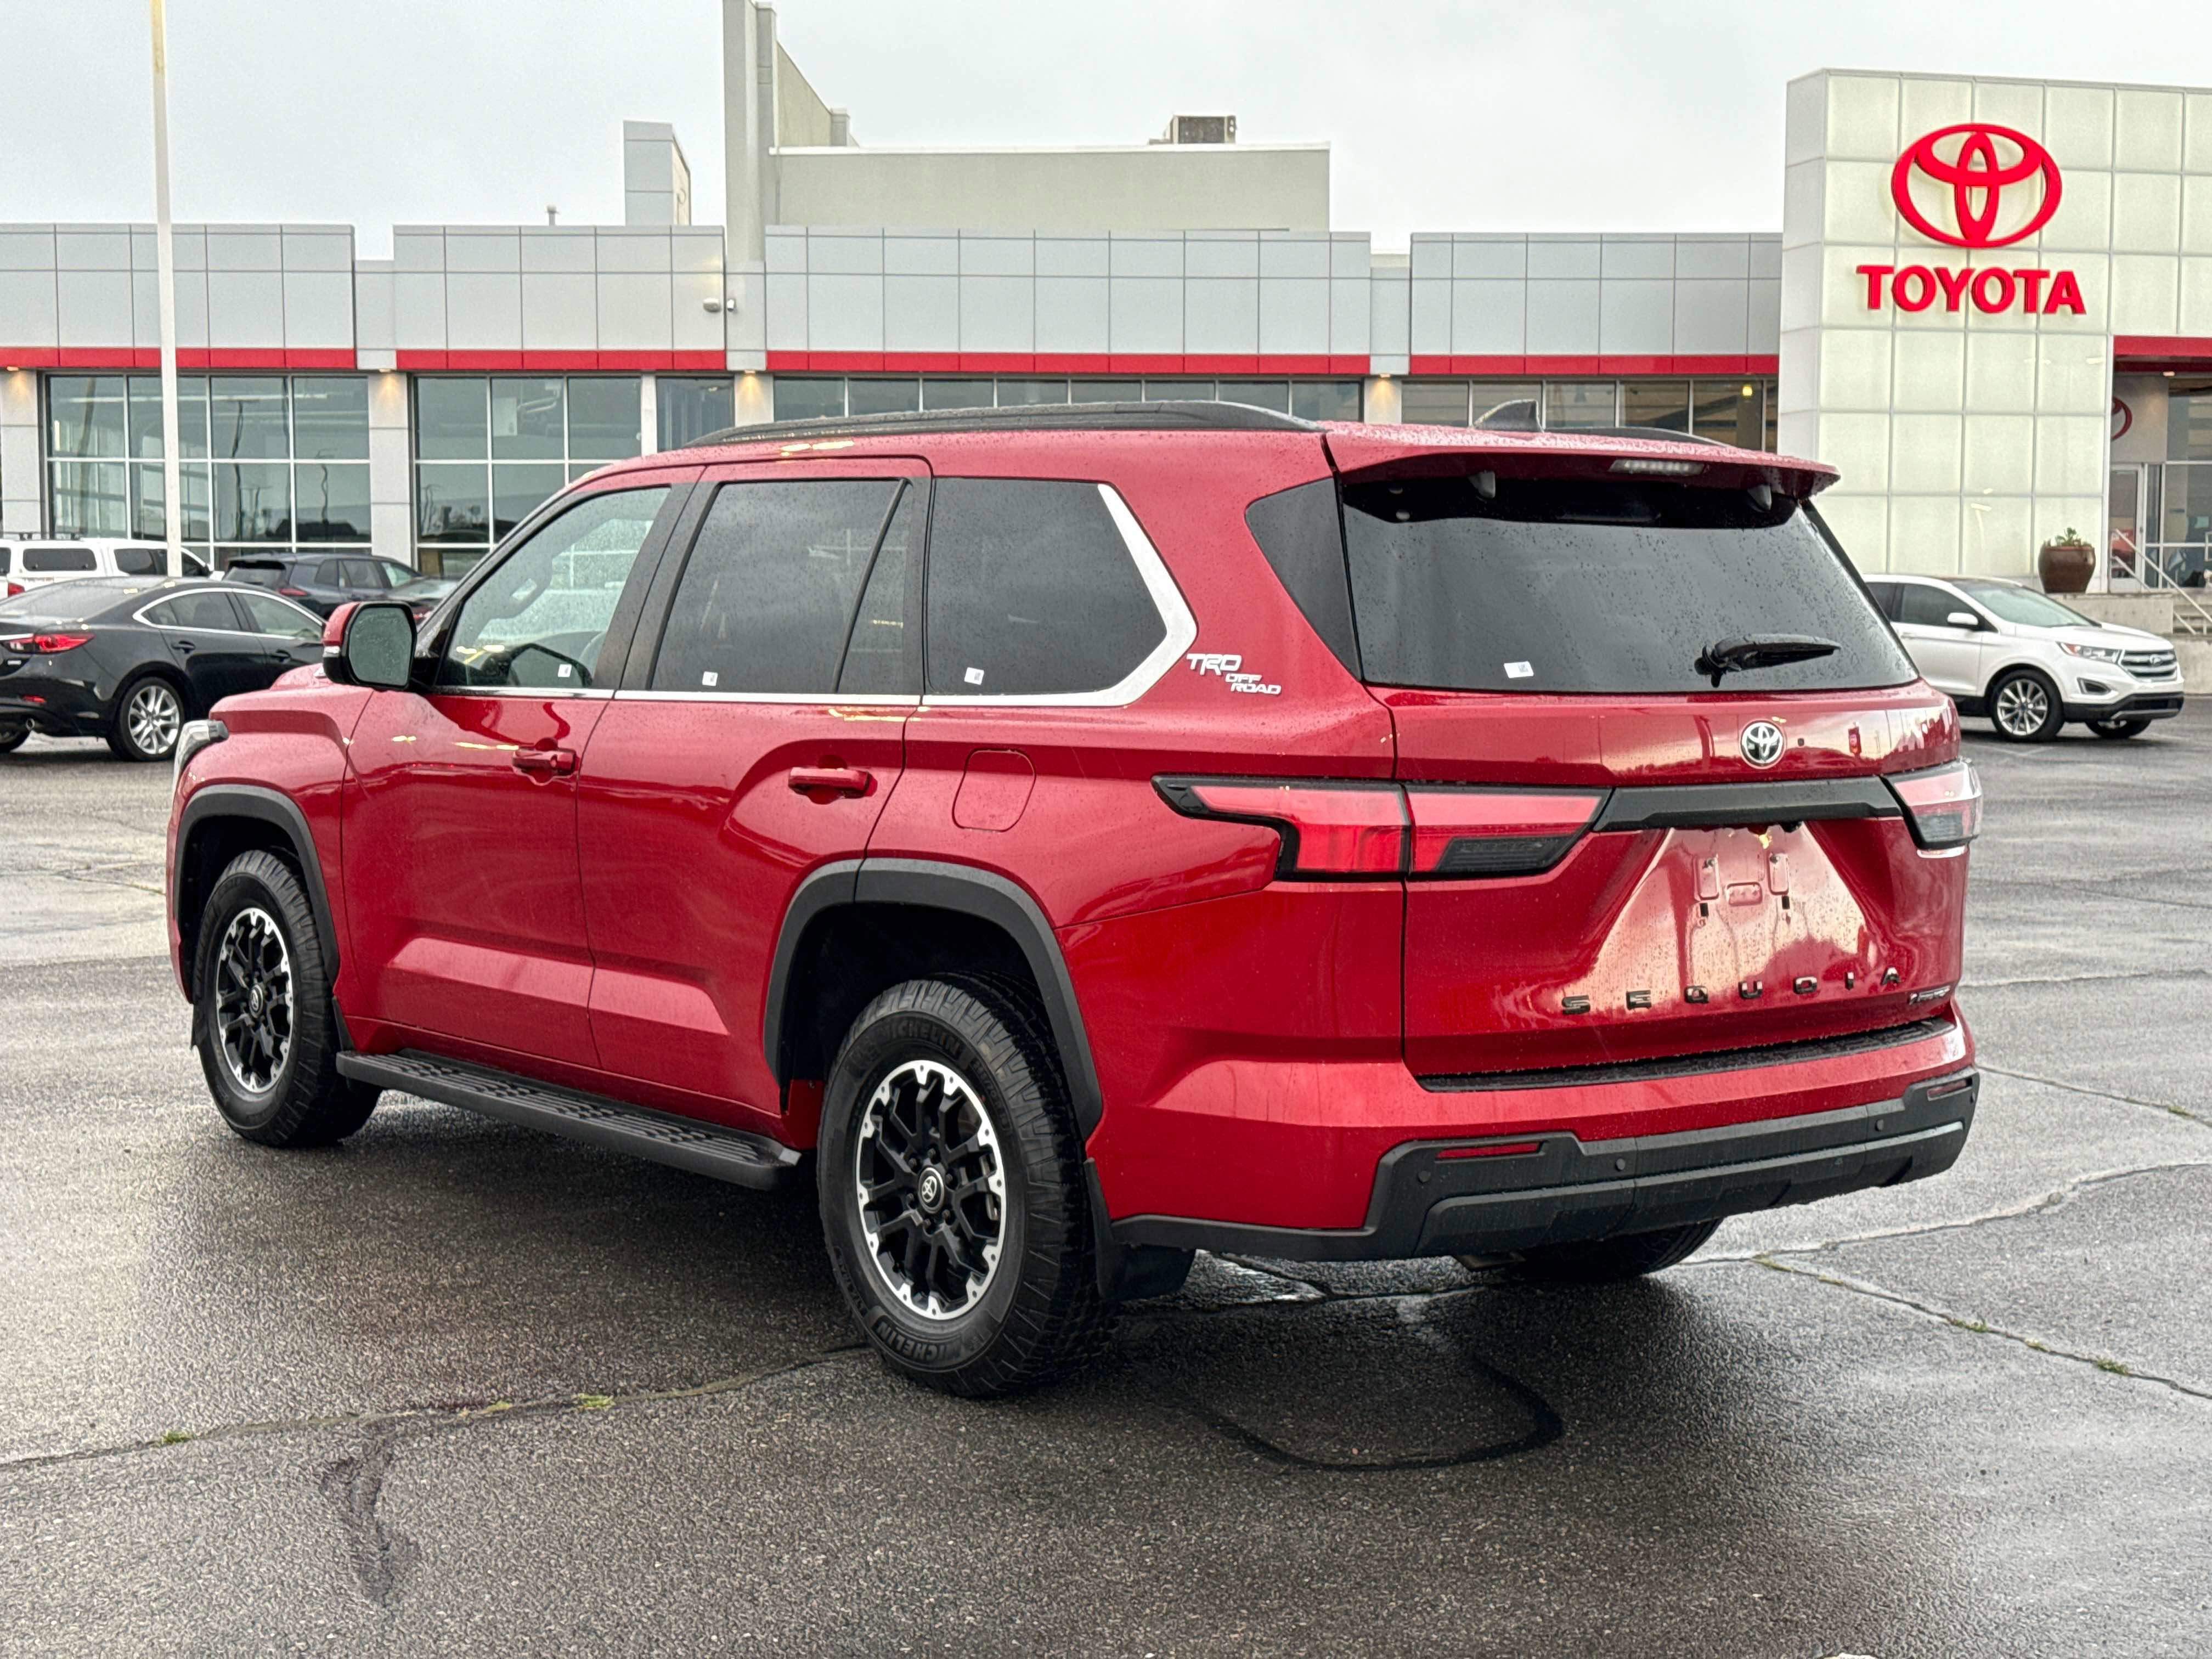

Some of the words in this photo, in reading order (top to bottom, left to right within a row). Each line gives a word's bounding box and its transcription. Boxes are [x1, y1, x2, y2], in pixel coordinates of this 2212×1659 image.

[1856, 264, 2087, 315] TOYOTA
[1186, 653, 1242, 675] TRD
[1225, 673, 1262, 682] OFF
[1230, 683, 1282, 695] ROAD
[1561, 967, 1901, 1014] SEQUOIA
[876, 1321, 962, 1361] MICHELIN
